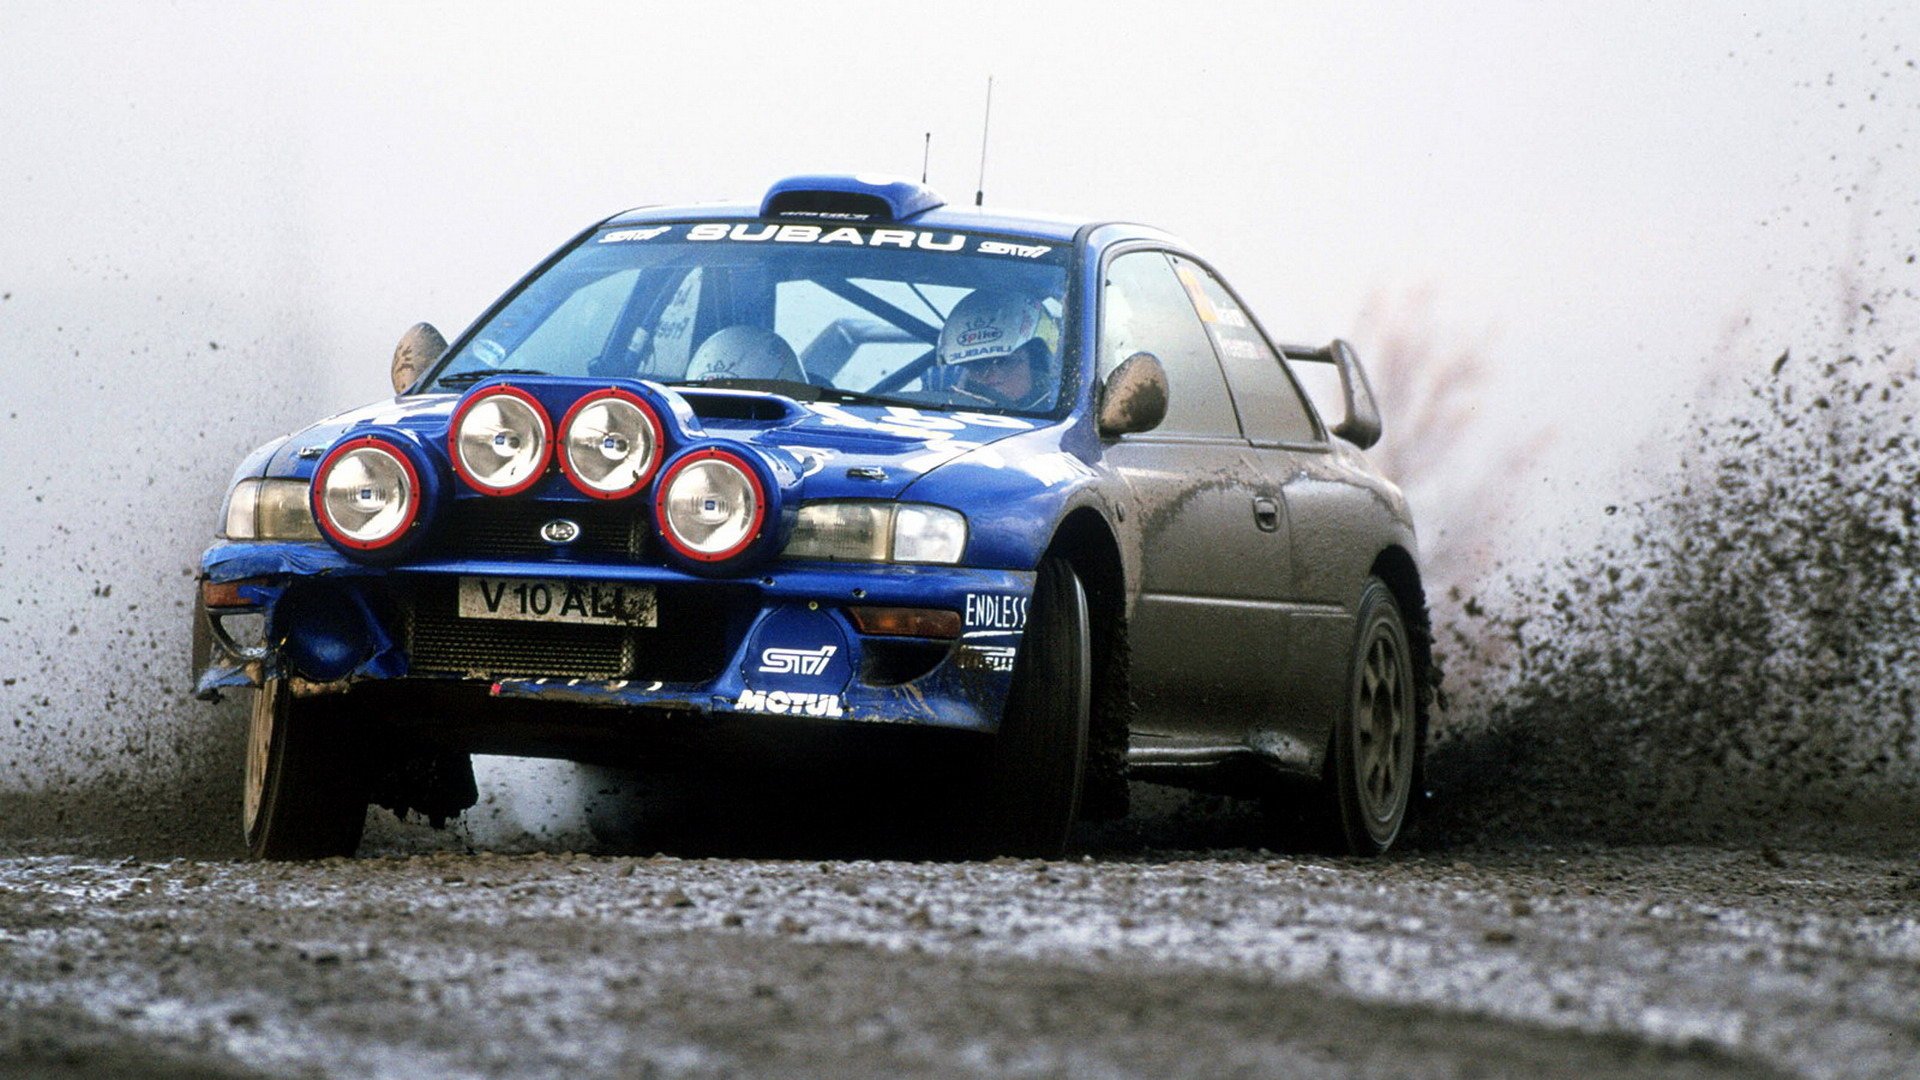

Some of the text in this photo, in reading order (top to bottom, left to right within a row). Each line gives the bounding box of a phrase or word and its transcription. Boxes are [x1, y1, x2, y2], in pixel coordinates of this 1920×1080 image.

[686, 223, 967, 251] SUBARU
[965, 593, 1028, 629] ENDLESS
[734, 690, 843, 718] MOTUL
